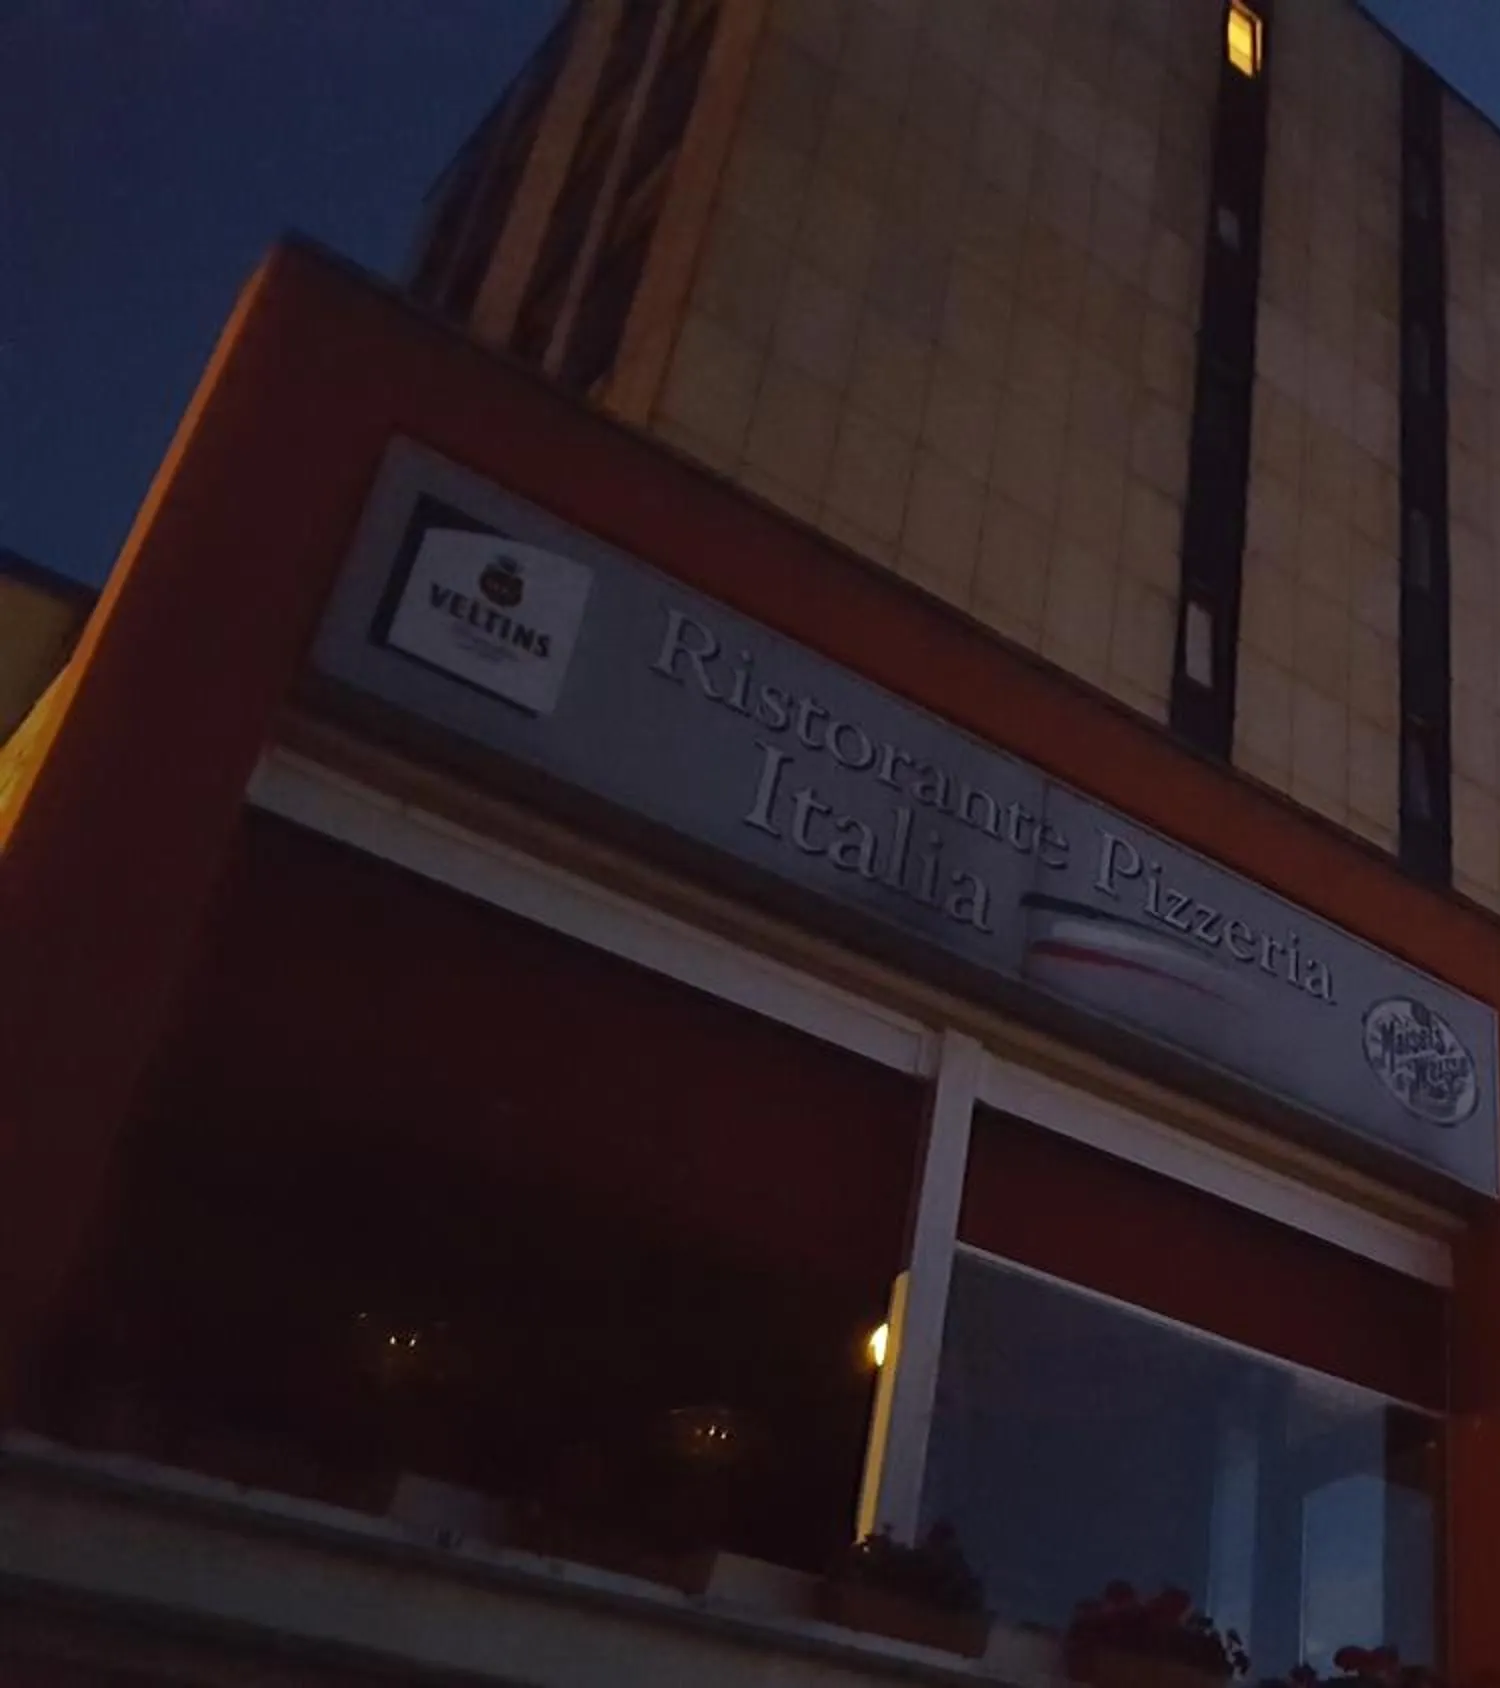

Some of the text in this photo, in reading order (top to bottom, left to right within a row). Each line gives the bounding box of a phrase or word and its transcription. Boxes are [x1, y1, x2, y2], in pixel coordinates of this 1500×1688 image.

[430, 582, 550, 657] VELTINS
[650, 608, 1337, 1004] Ristorante Pizzeria
[744, 742, 994, 933] Italia
